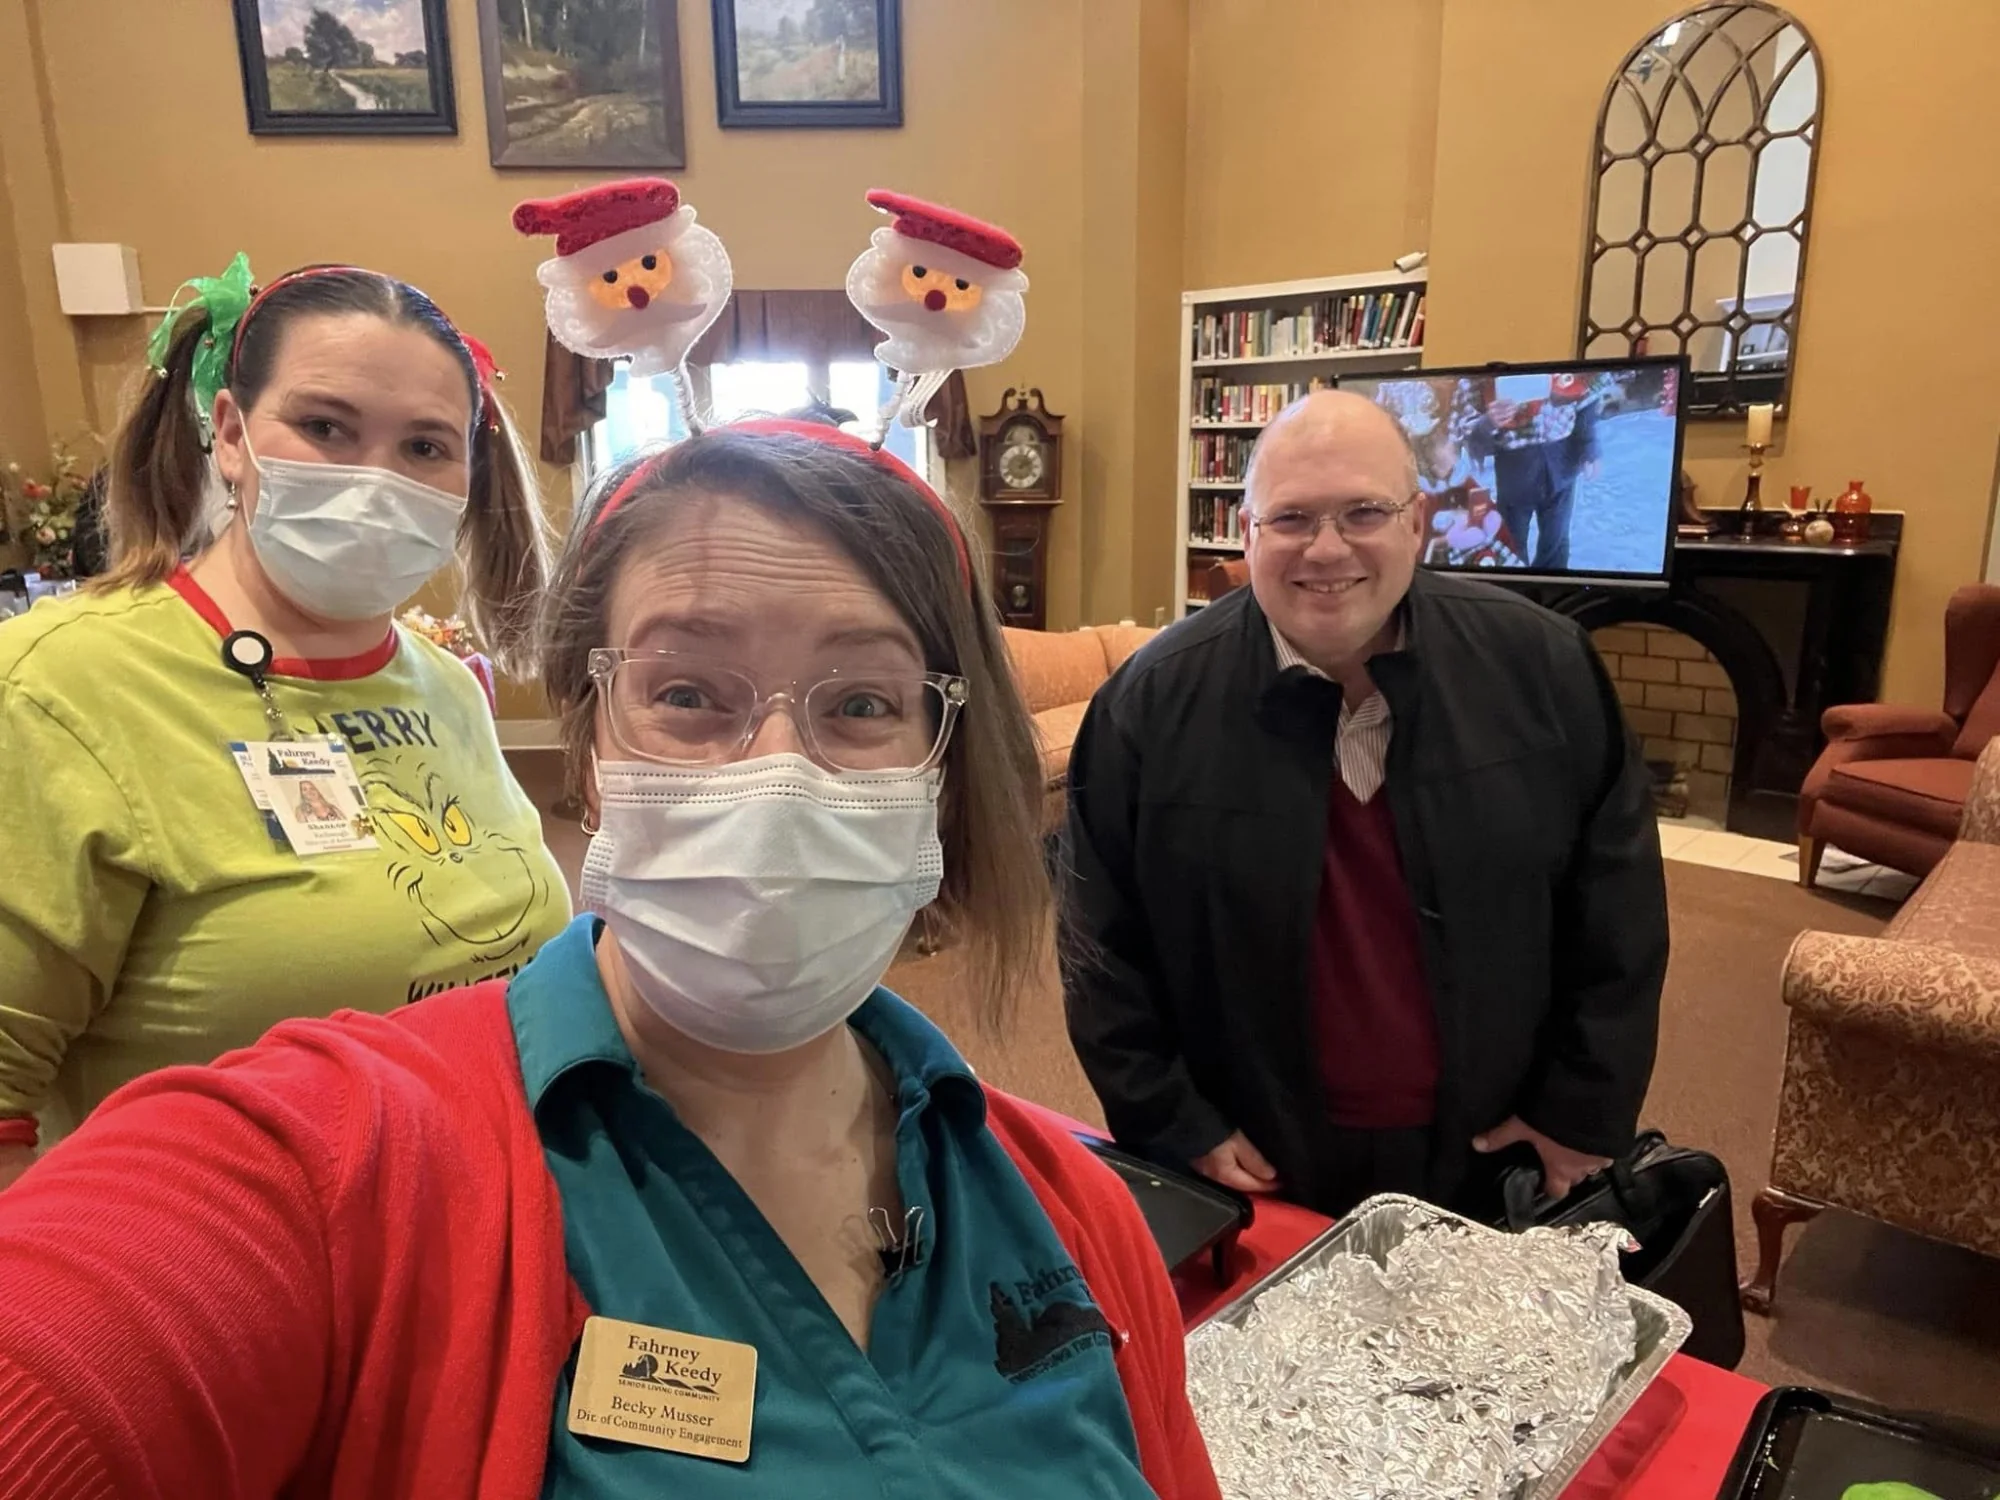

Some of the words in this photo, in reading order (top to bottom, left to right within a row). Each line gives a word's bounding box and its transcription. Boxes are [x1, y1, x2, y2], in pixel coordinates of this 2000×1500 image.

[293, 706, 438, 754] ERRY
[628, 1335, 700, 1364] Fahrney
[665, 1360, 722, 1387] Keedy
[618, 1379, 646, 1389] SENIOR
[648, 1384, 673, 1394] LIVING
[674, 1389, 721, 1402] COMMUNITY
[611, 1396, 656, 1418] Becky
[660, 1405, 714, 1426] Musser
[577, 1409, 597, 1422] Dir.
[600, 1413, 613, 1425] of
[613, 1415, 676, 1438] Community
[679, 1427, 742, 1448] Engagement
